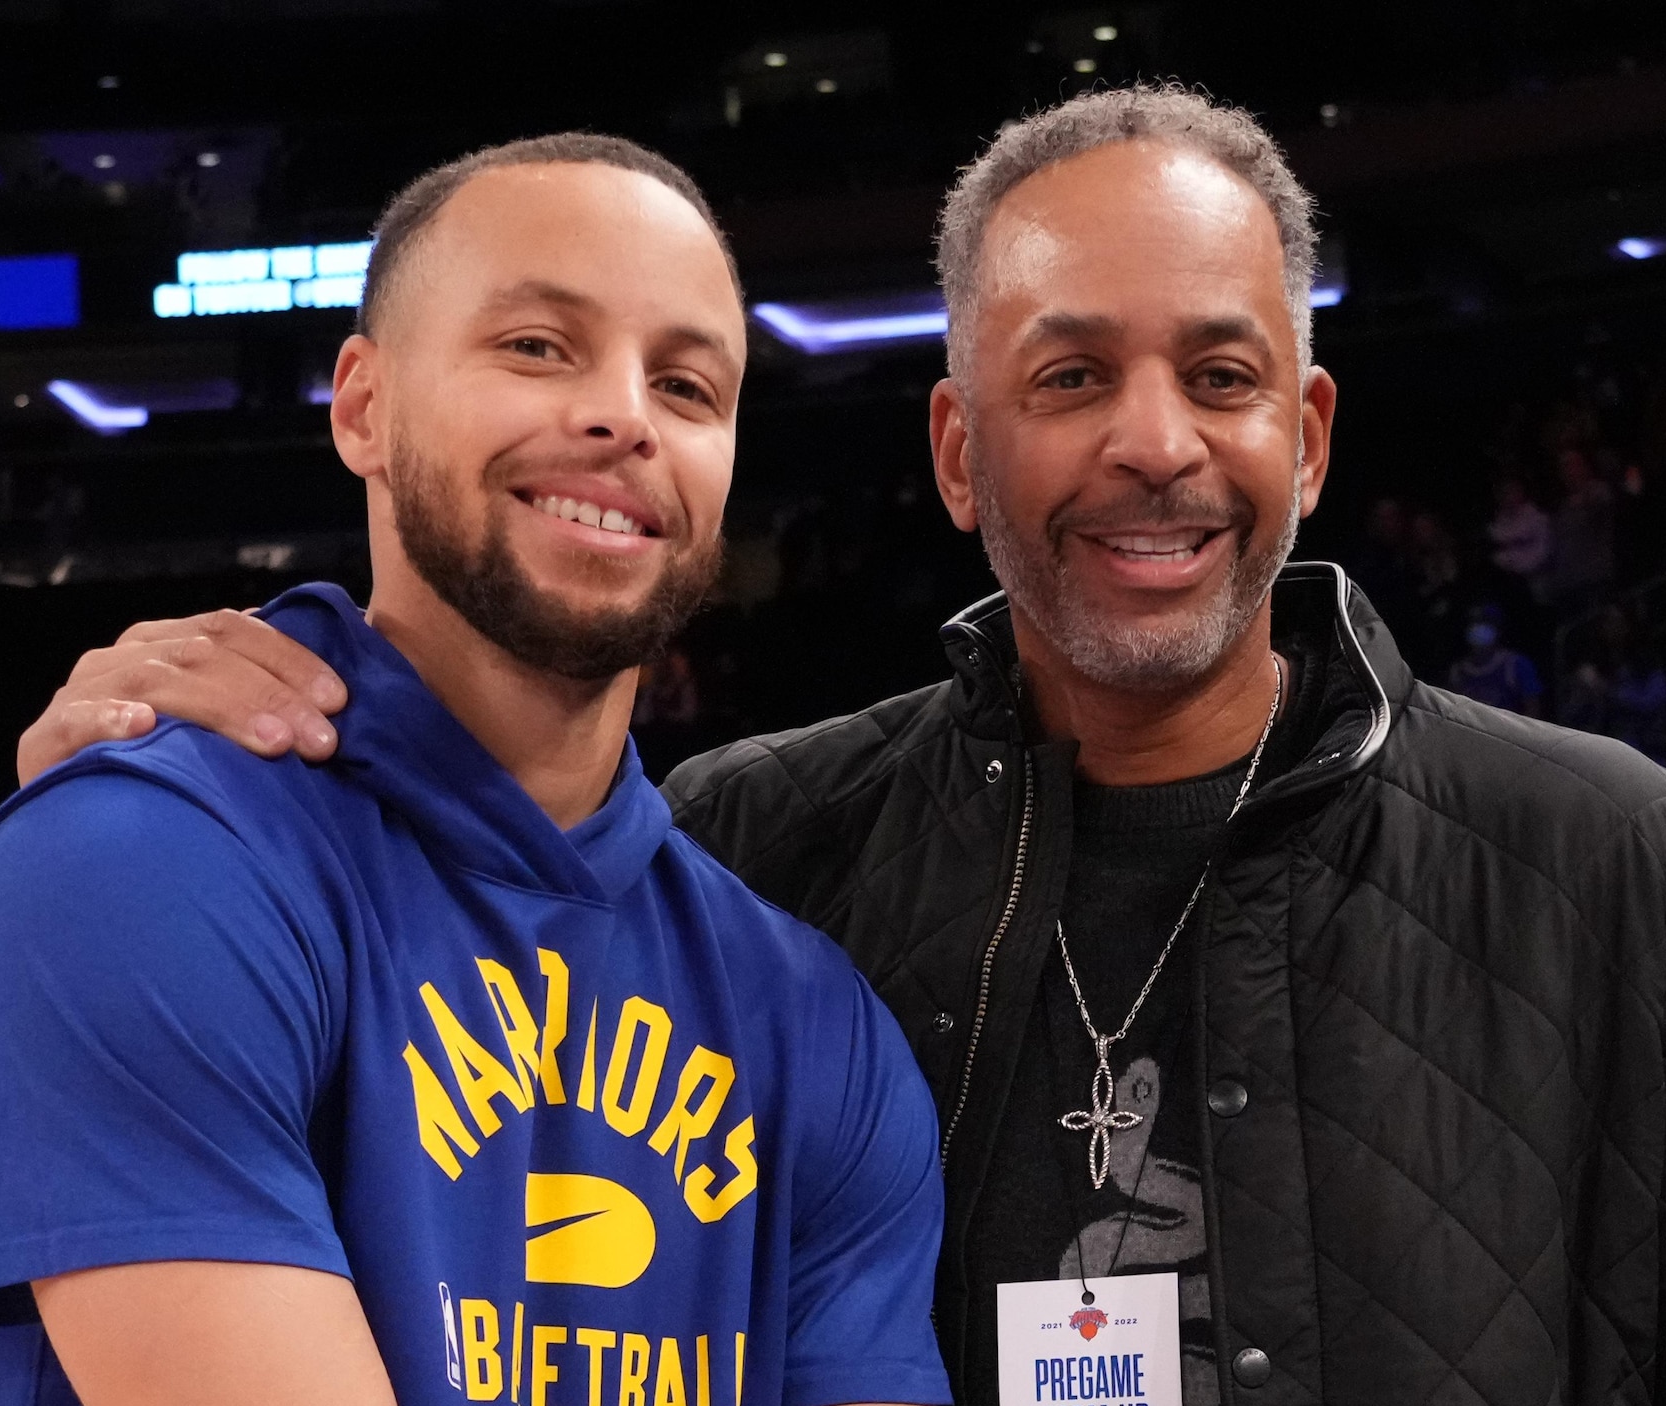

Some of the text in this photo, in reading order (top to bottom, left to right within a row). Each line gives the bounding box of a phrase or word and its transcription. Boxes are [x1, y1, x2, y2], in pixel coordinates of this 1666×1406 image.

[1040, 1322, 1063, 1330] 2021
[1114, 1318, 1138, 1326] 2022
[1035, 1353, 1146, 1402] PREGAME
